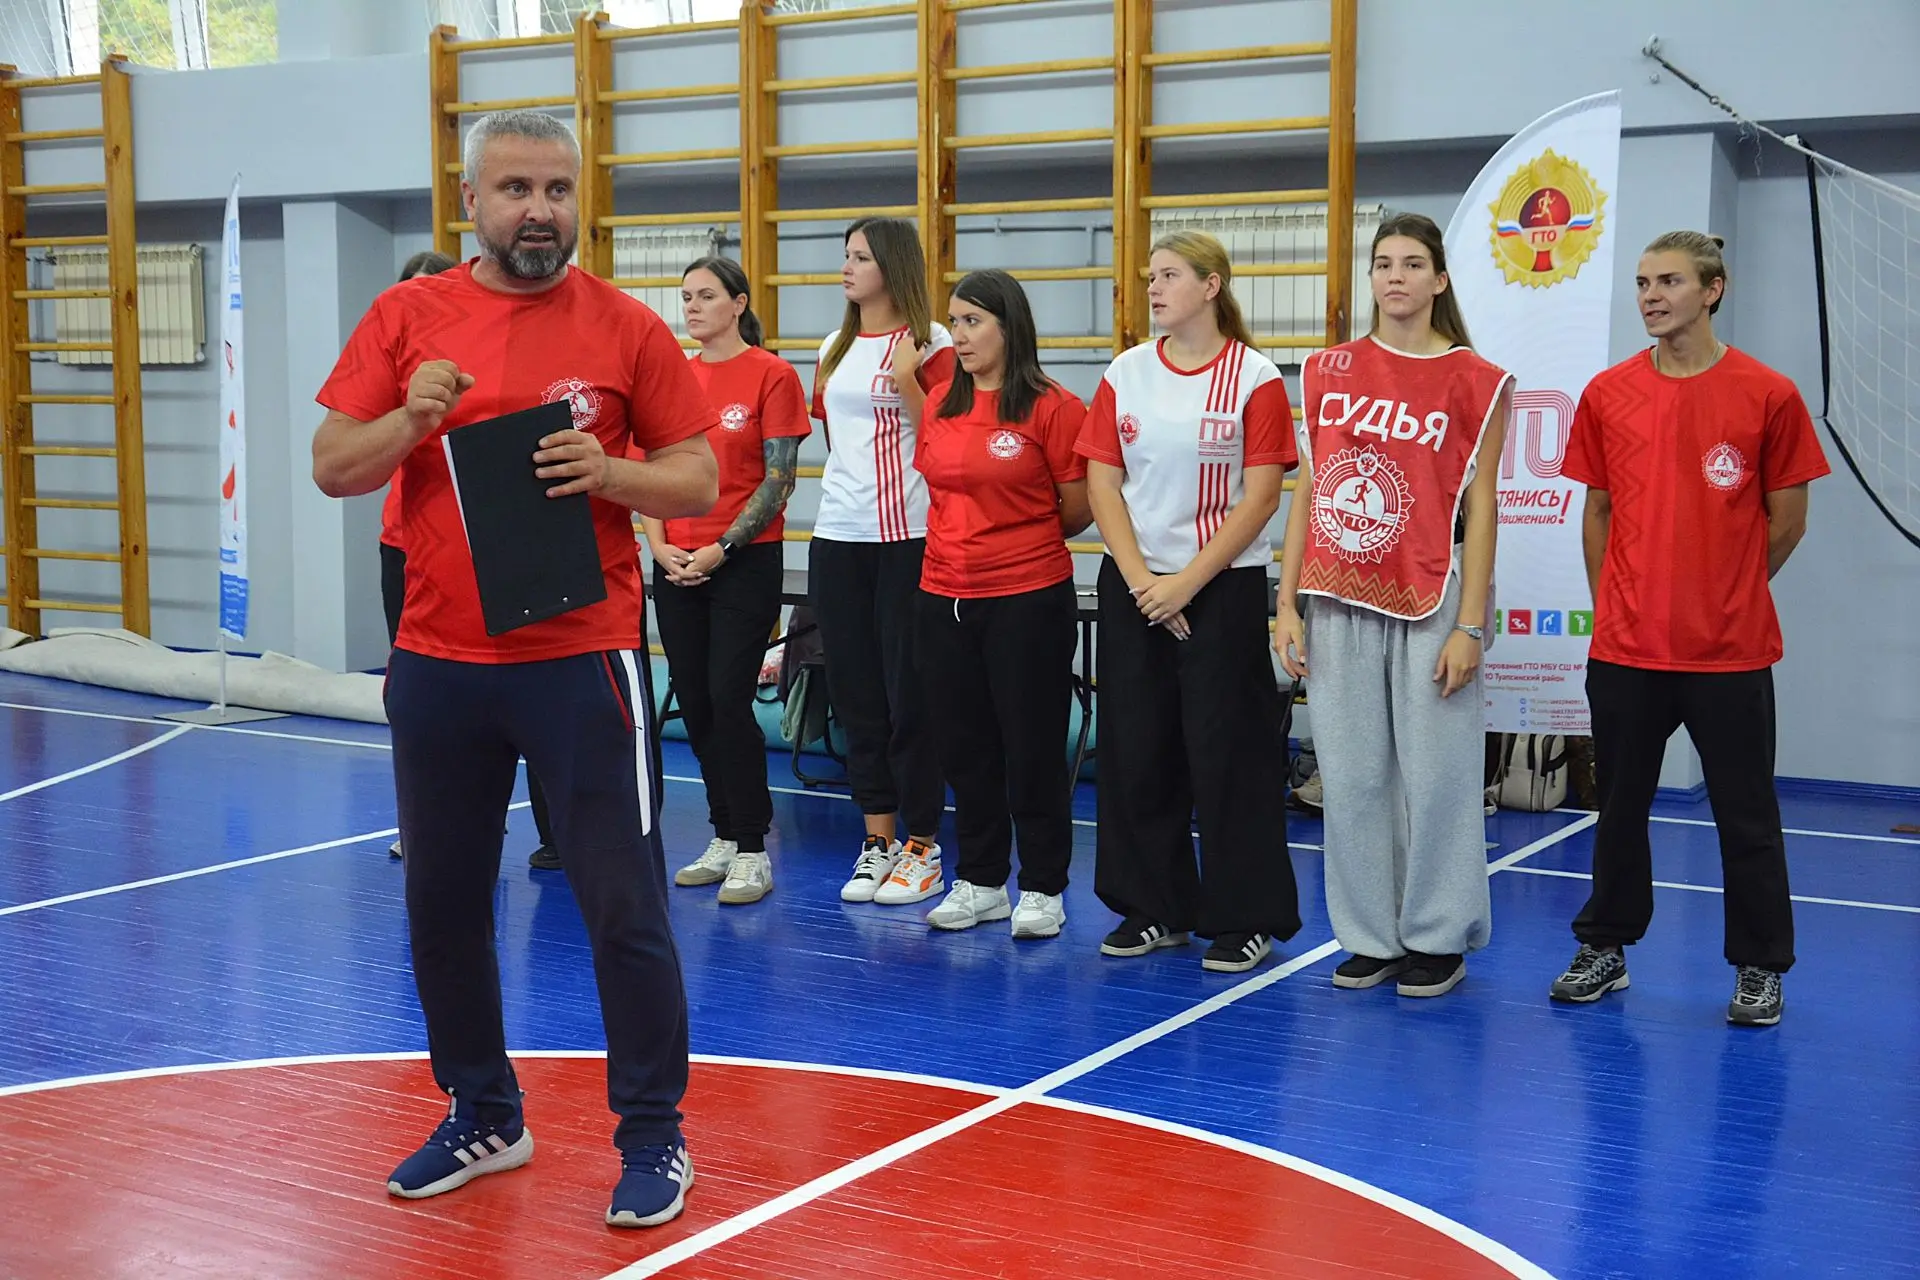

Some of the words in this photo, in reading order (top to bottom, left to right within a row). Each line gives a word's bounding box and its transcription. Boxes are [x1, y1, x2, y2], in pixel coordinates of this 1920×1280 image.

[1531, 230, 1557, 244] ГТО
[1318, 350, 1353, 370] ГТО
[1199, 418, 1236, 441] ГТО
[1318, 392, 1450, 452] СУДЬЯ
[1501, 389, 1576, 479] ТО
[1497, 489, 1561, 508] ТЯНИСЬ
[1342, 512, 1369, 530] ГТО
[1485, 663, 1522, 671] тирования
[1524, 662, 1539, 670] ГТО
[1540, 663, 1558, 671] МБУ
[1542, 674, 1565, 683] район
